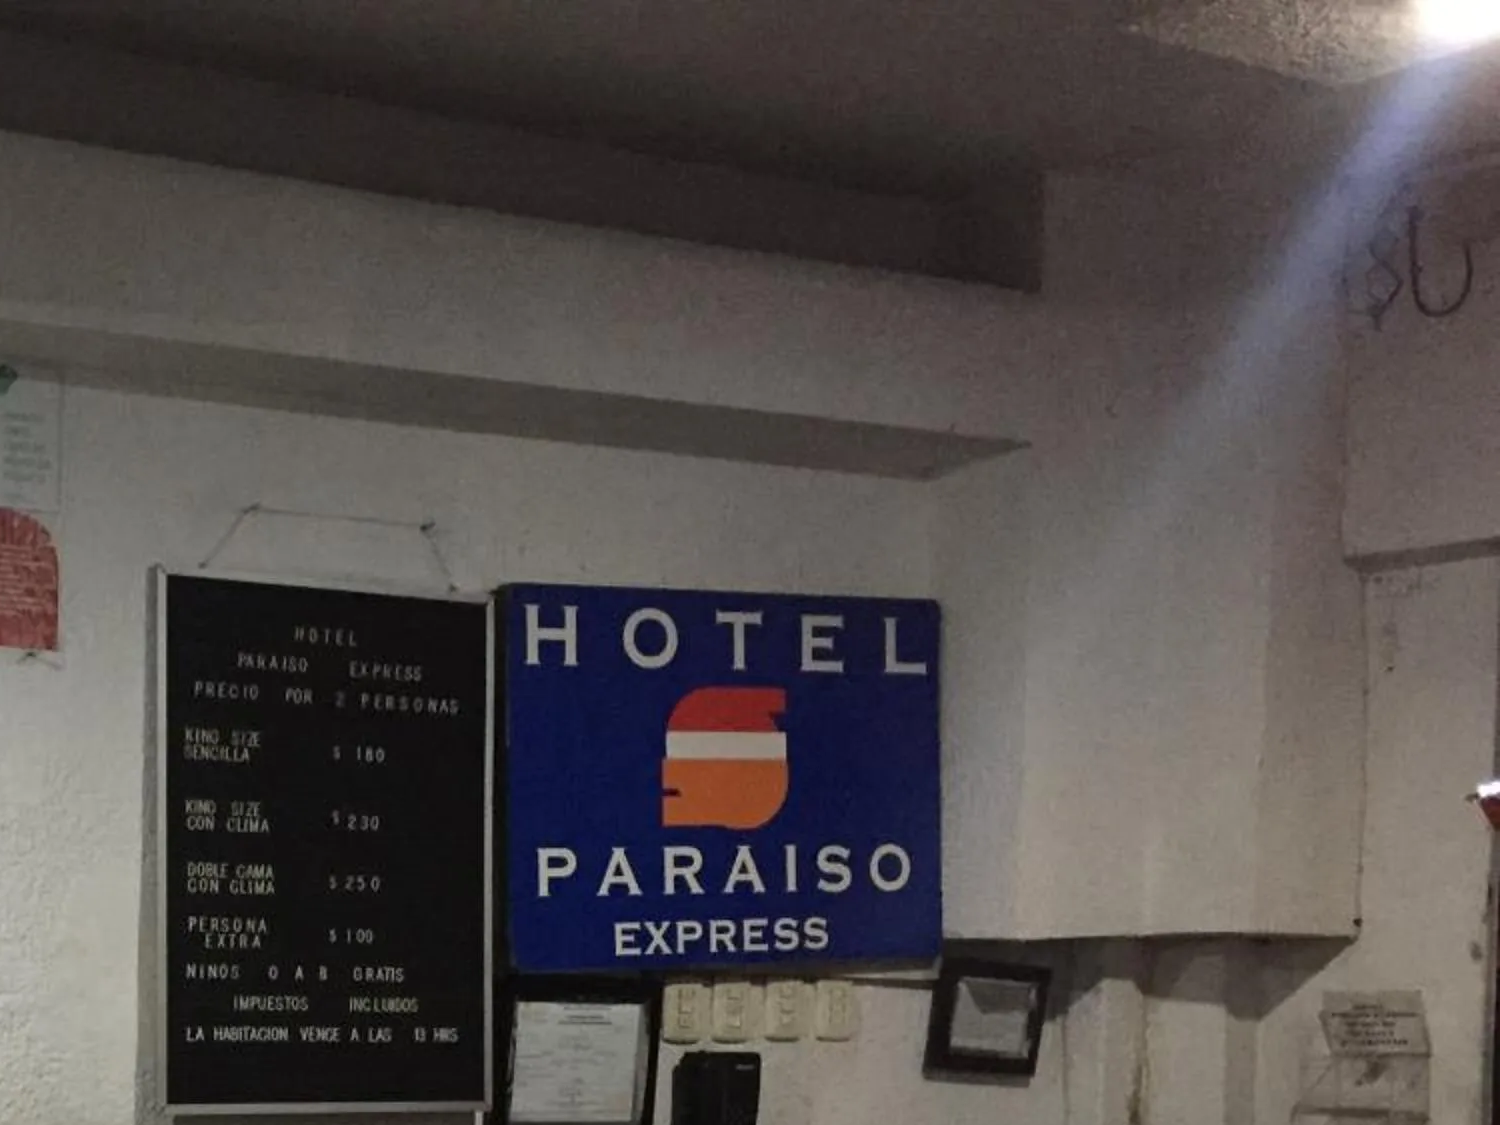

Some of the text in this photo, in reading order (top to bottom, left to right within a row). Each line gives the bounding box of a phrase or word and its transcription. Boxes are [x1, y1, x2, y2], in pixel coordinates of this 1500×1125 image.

[294, 626, 357, 647] HOTEL
[524, 604, 927, 675] HOTEL
[237, 652, 423, 682] PARAISO EXPRESS
[194, 681, 260, 701] PRECIO
[285, 687, 313, 705] POR
[361, 693, 460, 715] PERSONAS
[232, 730, 261, 748] SIZE
[183, 745, 250, 763] SENCILLA
[356, 746, 386, 763] 180
[231, 800, 261, 817] SIZE
[186, 816, 270, 834] CON CLIMA
[348, 815, 380, 832] 230
[187, 861, 275, 880] DOBLE CAMA
[536, 843, 911, 897] PARAISO
[187, 879, 276, 896] CON CLIMA
[345, 875, 381, 892] 250
[187, 916, 268, 933] PERSONA
[204, 933, 262, 950] EXTRA
[347, 929, 374, 944] 100
[614, 917, 830, 956] EXPRESS
[294, 966, 305, 981] A
[352, 967, 405, 983] GRATIS
[233, 995, 419, 1013] IMPUESTOS INCLUIDOS
[185, 1026, 205, 1042] LA
[213, 1026, 289, 1042] HABITACION
[299, 1027, 340, 1043] VENCE
[350, 1027, 360, 1042] A
[368, 1027, 392, 1043] LAS
